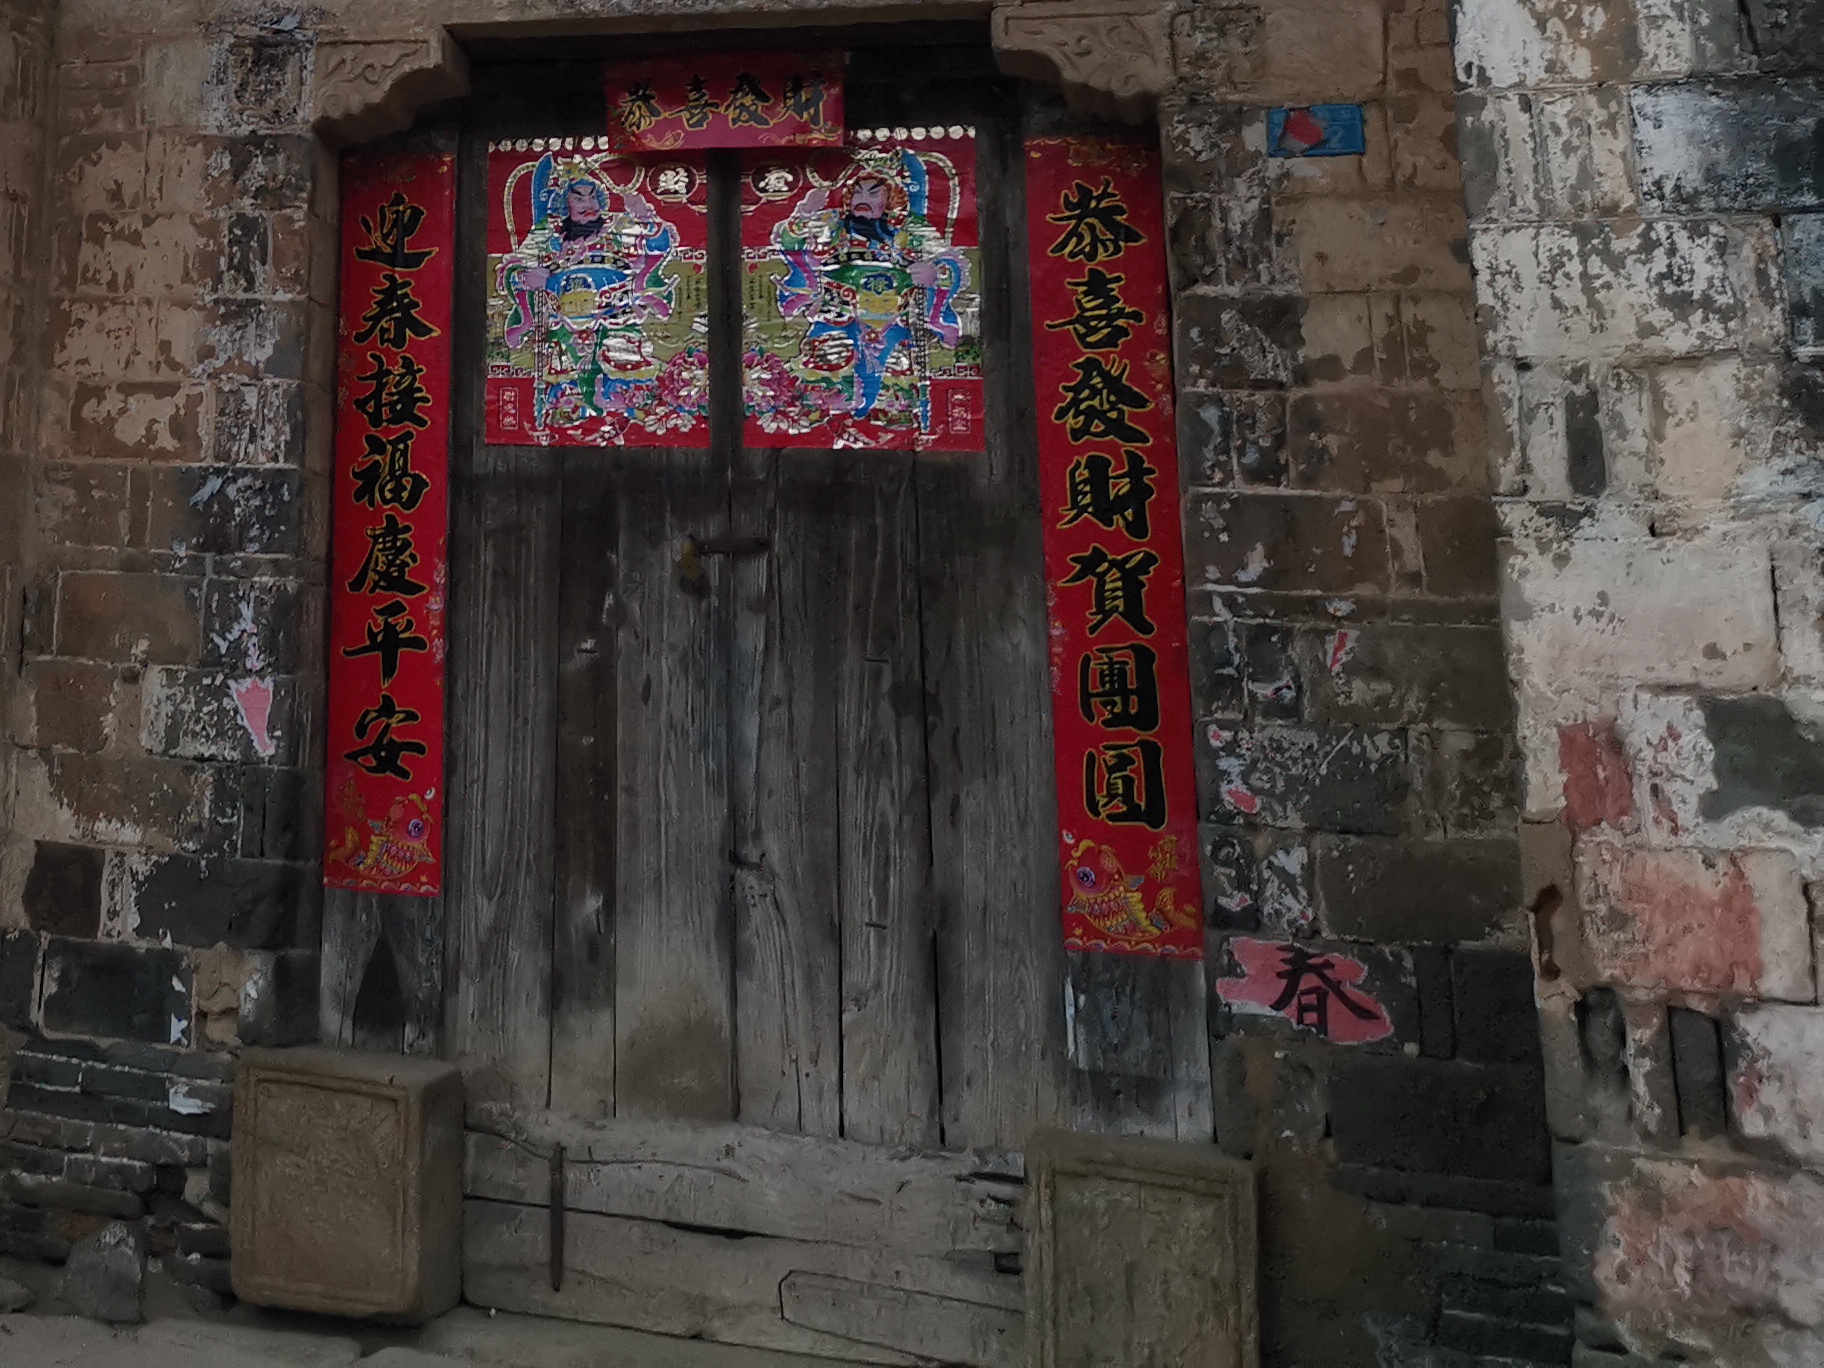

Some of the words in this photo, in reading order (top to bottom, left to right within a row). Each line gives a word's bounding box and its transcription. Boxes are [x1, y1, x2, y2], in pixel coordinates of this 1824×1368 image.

[619, 68, 828, 134] 恭喜發財
[342, 191, 443, 783] 迎春接福慶平安
[1044, 178, 1168, 831] 恭喜發財賀團圓
[1269, 943, 1382, 1036] 春
